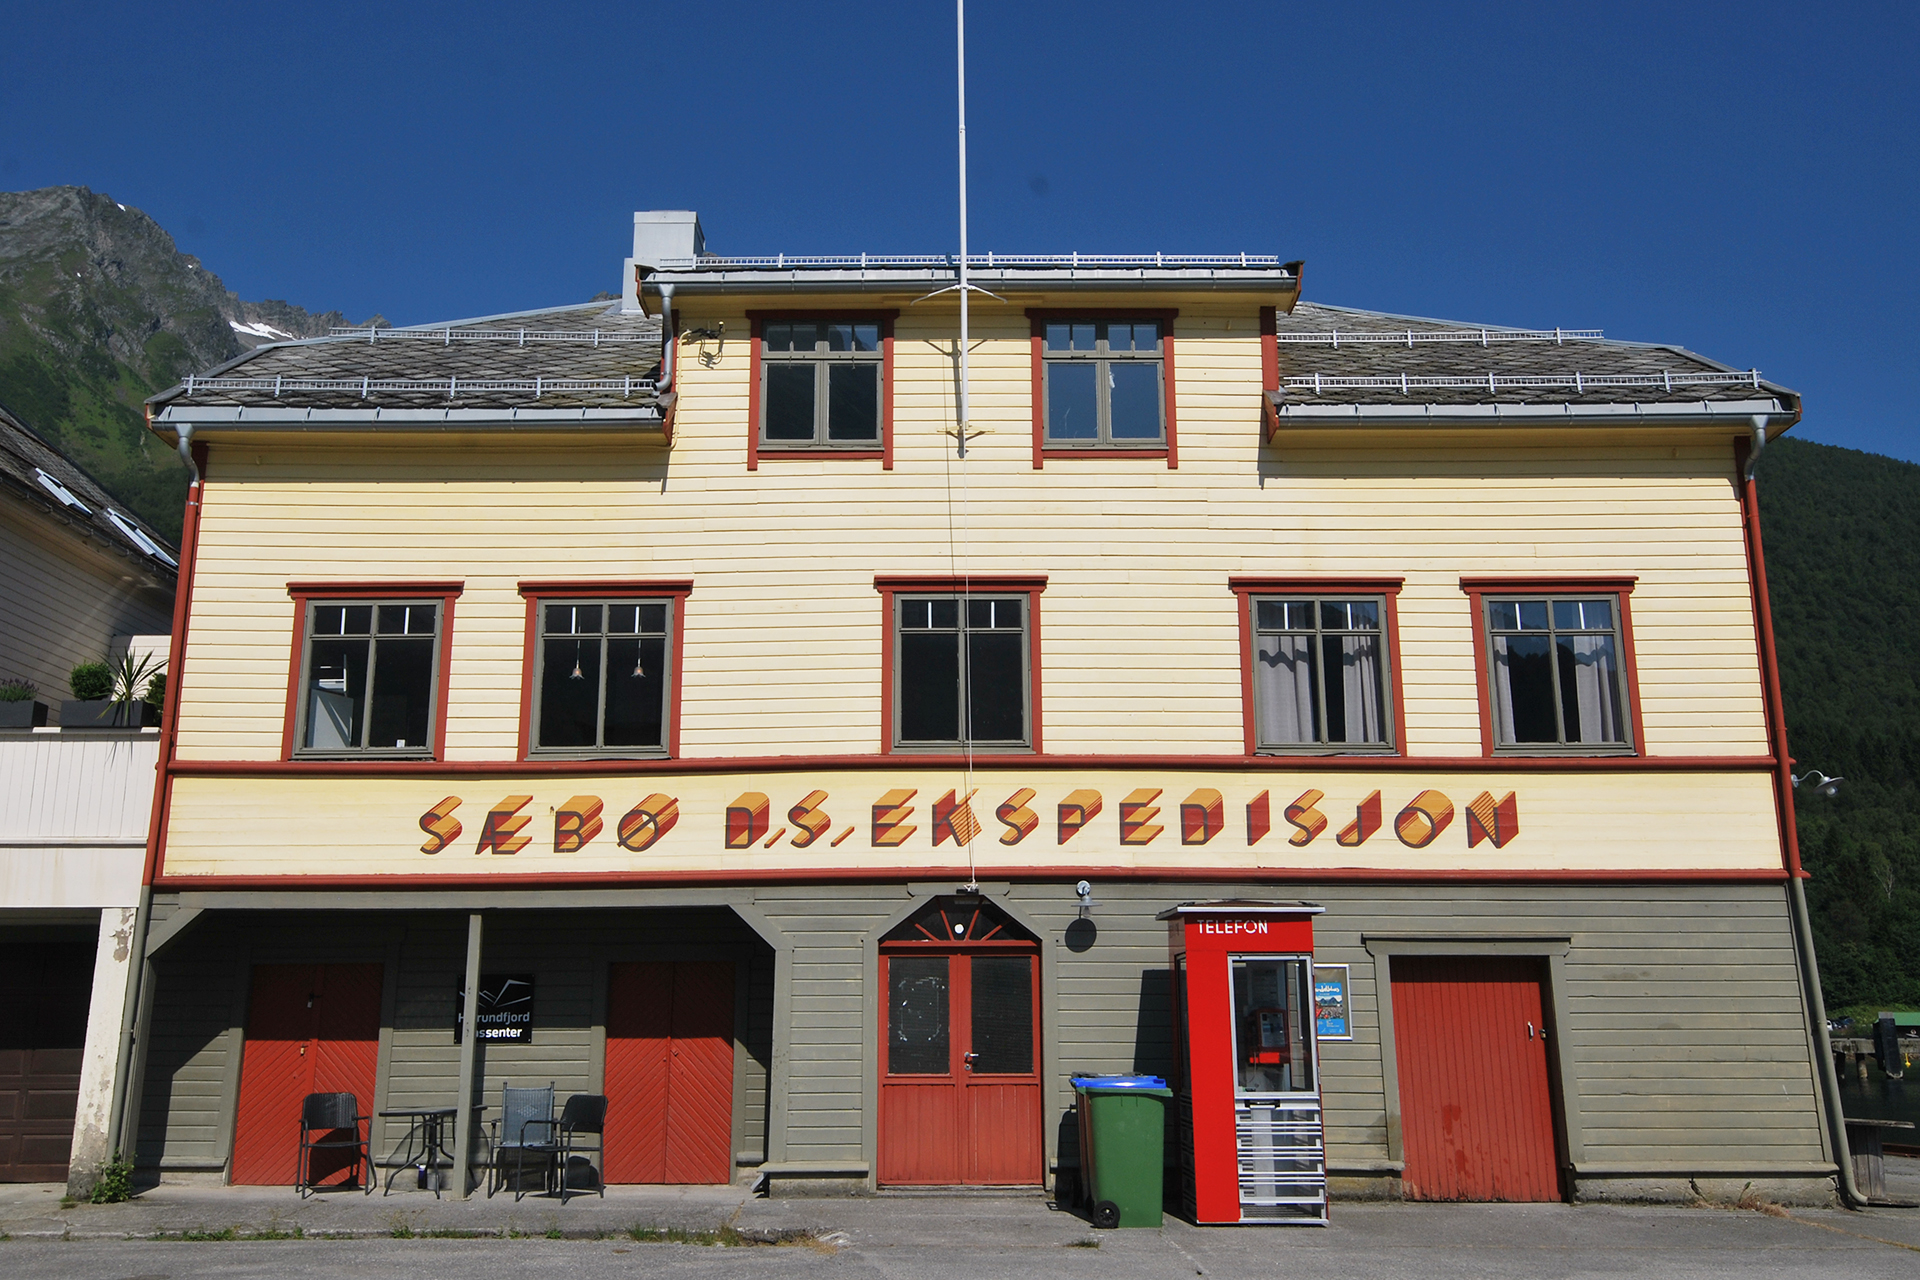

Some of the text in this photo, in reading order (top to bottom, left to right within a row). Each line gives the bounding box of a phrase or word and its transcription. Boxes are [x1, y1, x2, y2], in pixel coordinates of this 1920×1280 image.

[419, 792, 680, 856] SÆBØ
[1197, 919, 1268, 935] TELEFON
[458, 1012, 530, 1025] Hrundfjord
